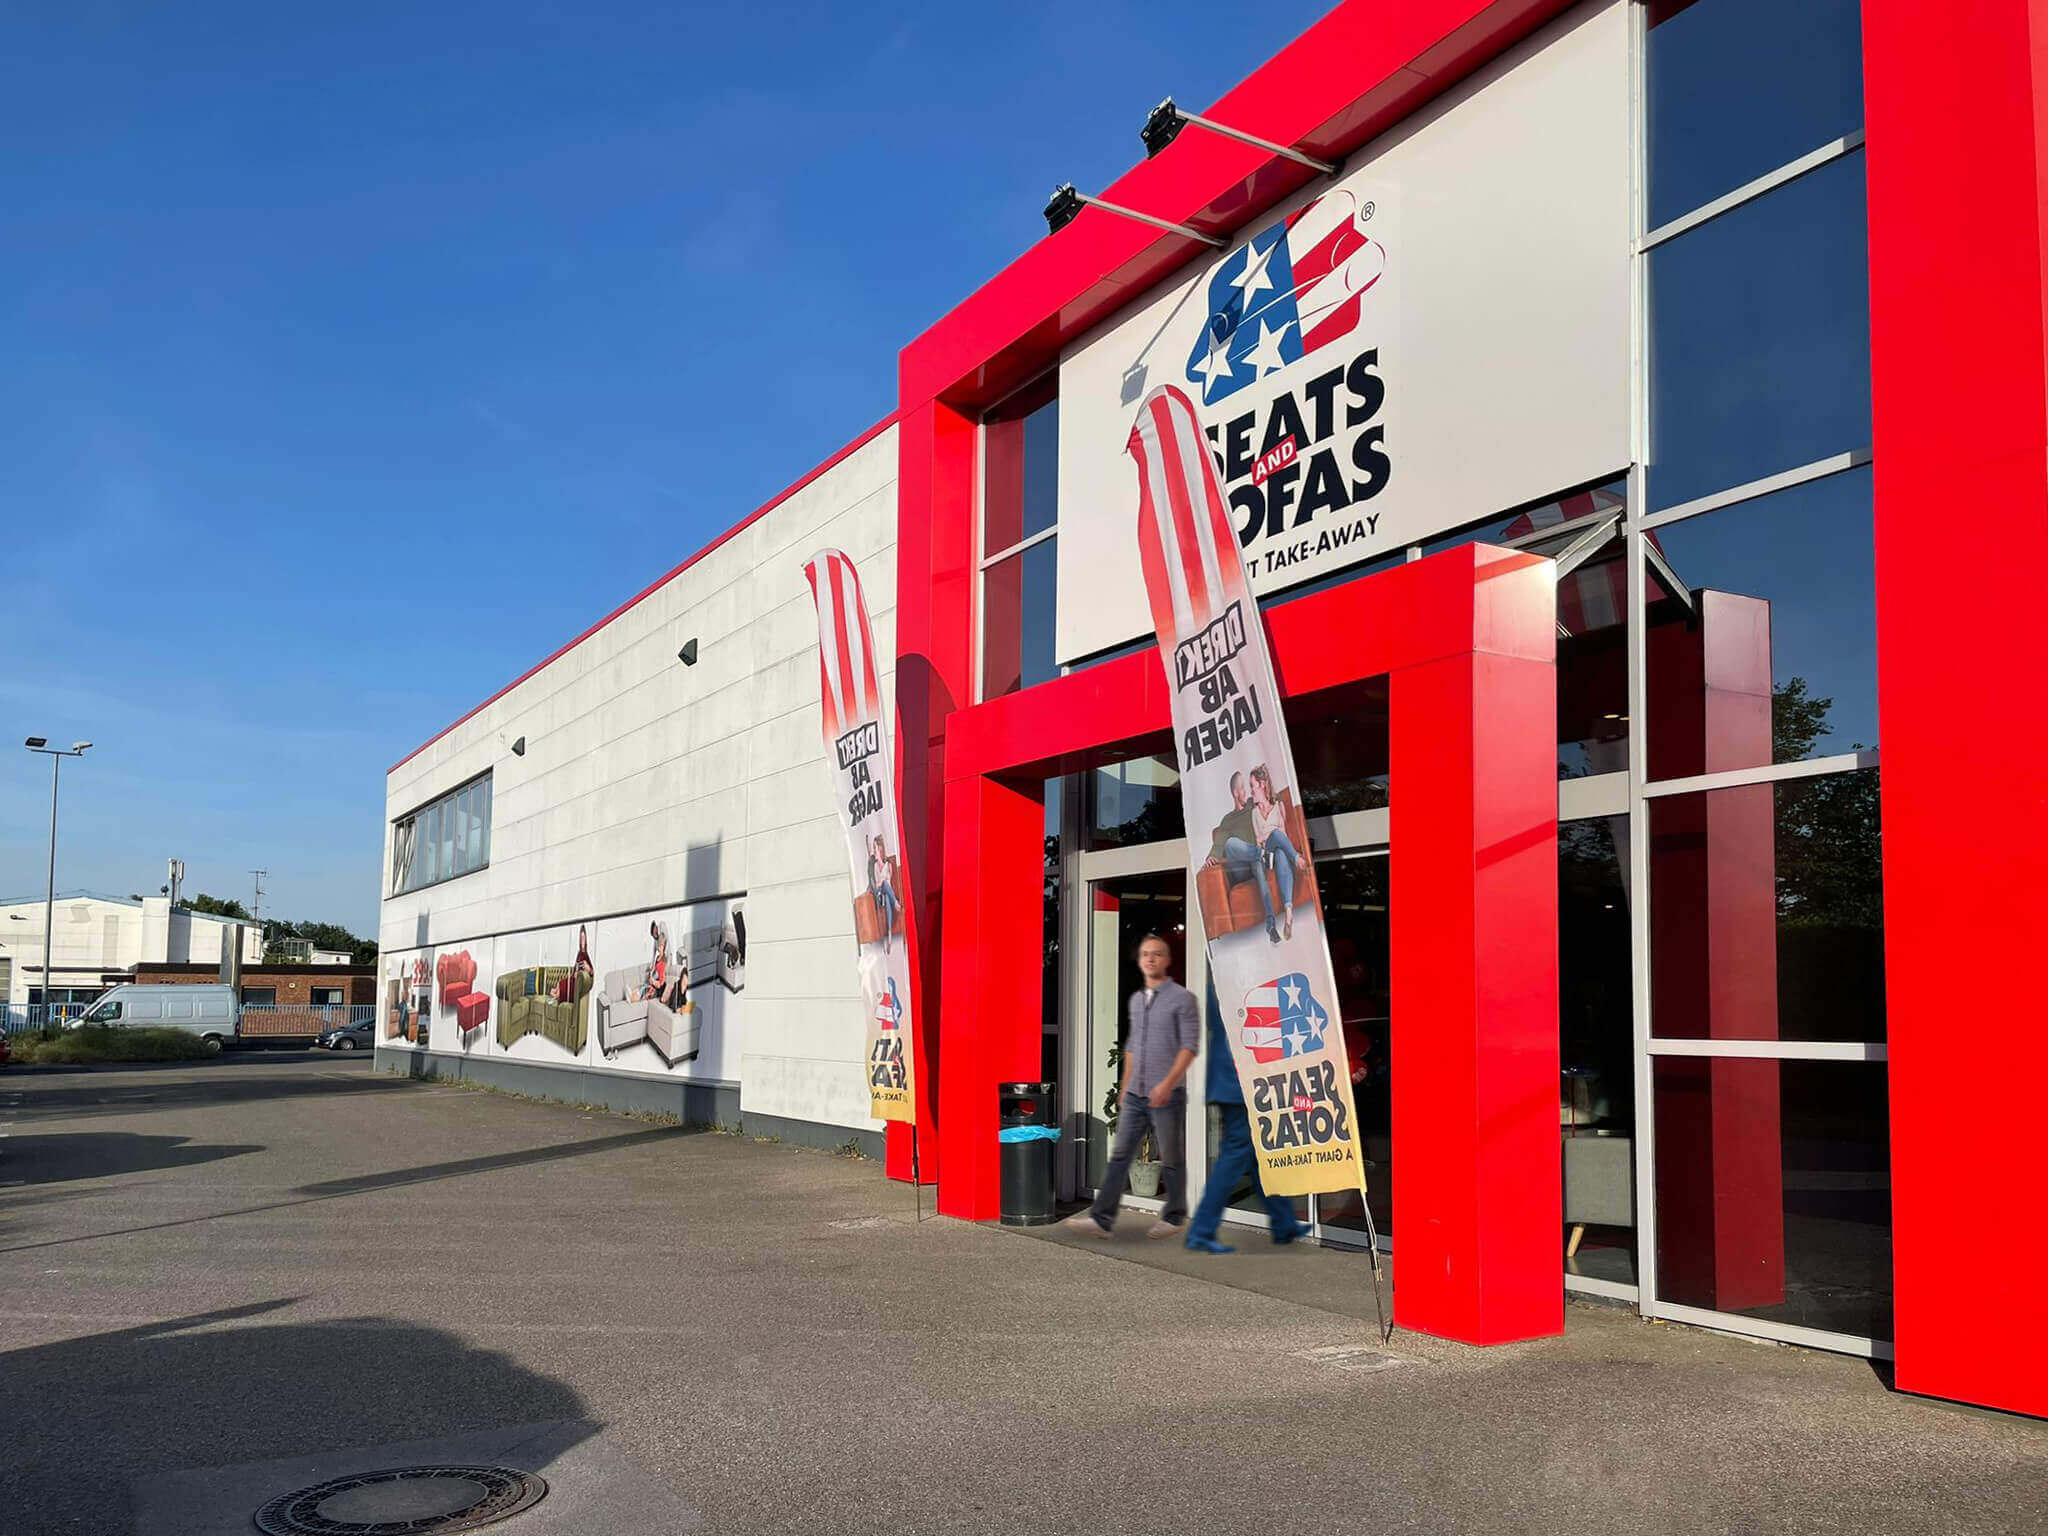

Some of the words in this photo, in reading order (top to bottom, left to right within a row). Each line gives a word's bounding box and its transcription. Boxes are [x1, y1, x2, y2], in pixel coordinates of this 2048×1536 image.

[1229, 425, 1391, 549] OFAS
[1254, 441, 1295, 480] AND
[1265, 512, 1380, 573] TAKE-AWAY
